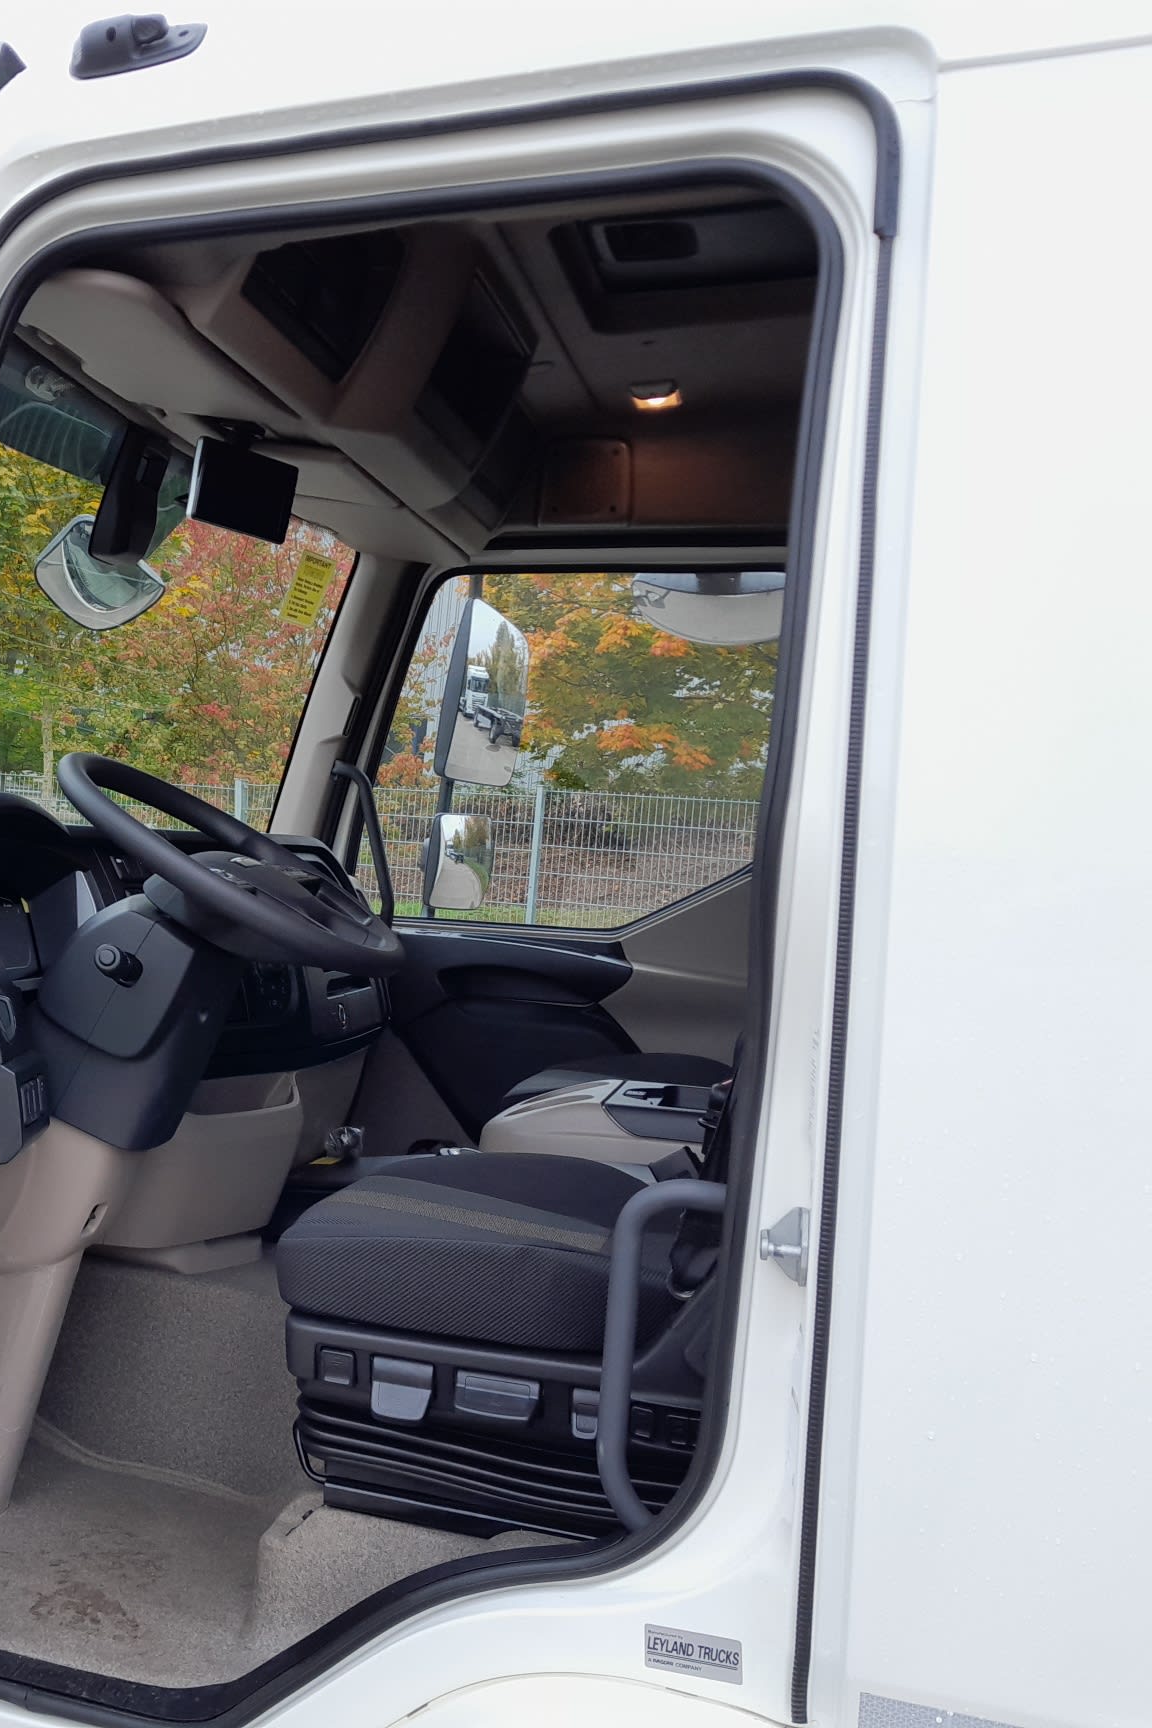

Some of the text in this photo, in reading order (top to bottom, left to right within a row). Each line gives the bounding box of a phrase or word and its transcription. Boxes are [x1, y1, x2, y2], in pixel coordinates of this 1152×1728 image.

[647, 1635, 739, 1666] LEYLAND TRUCKS
[675, 1662, 703, 1672] COMPANY
